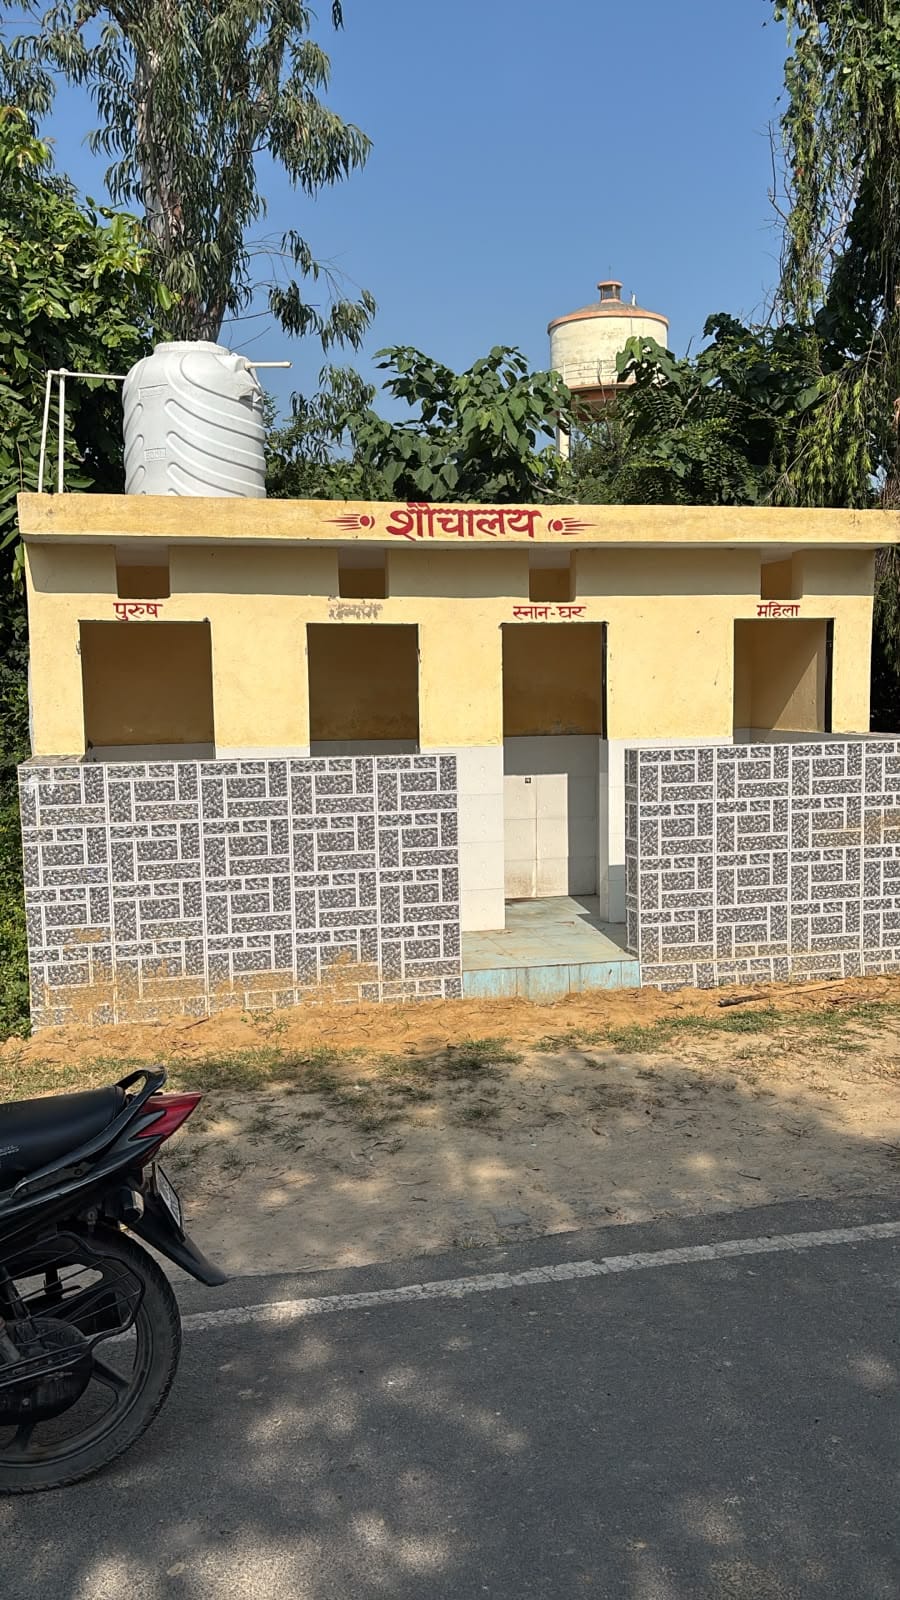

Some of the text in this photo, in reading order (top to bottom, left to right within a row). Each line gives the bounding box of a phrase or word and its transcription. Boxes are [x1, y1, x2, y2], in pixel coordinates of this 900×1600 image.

[386, 502, 542, 541] शौचालय
[113, 602, 163, 621] पुरुष
[756, 601, 801, 618] महिला
